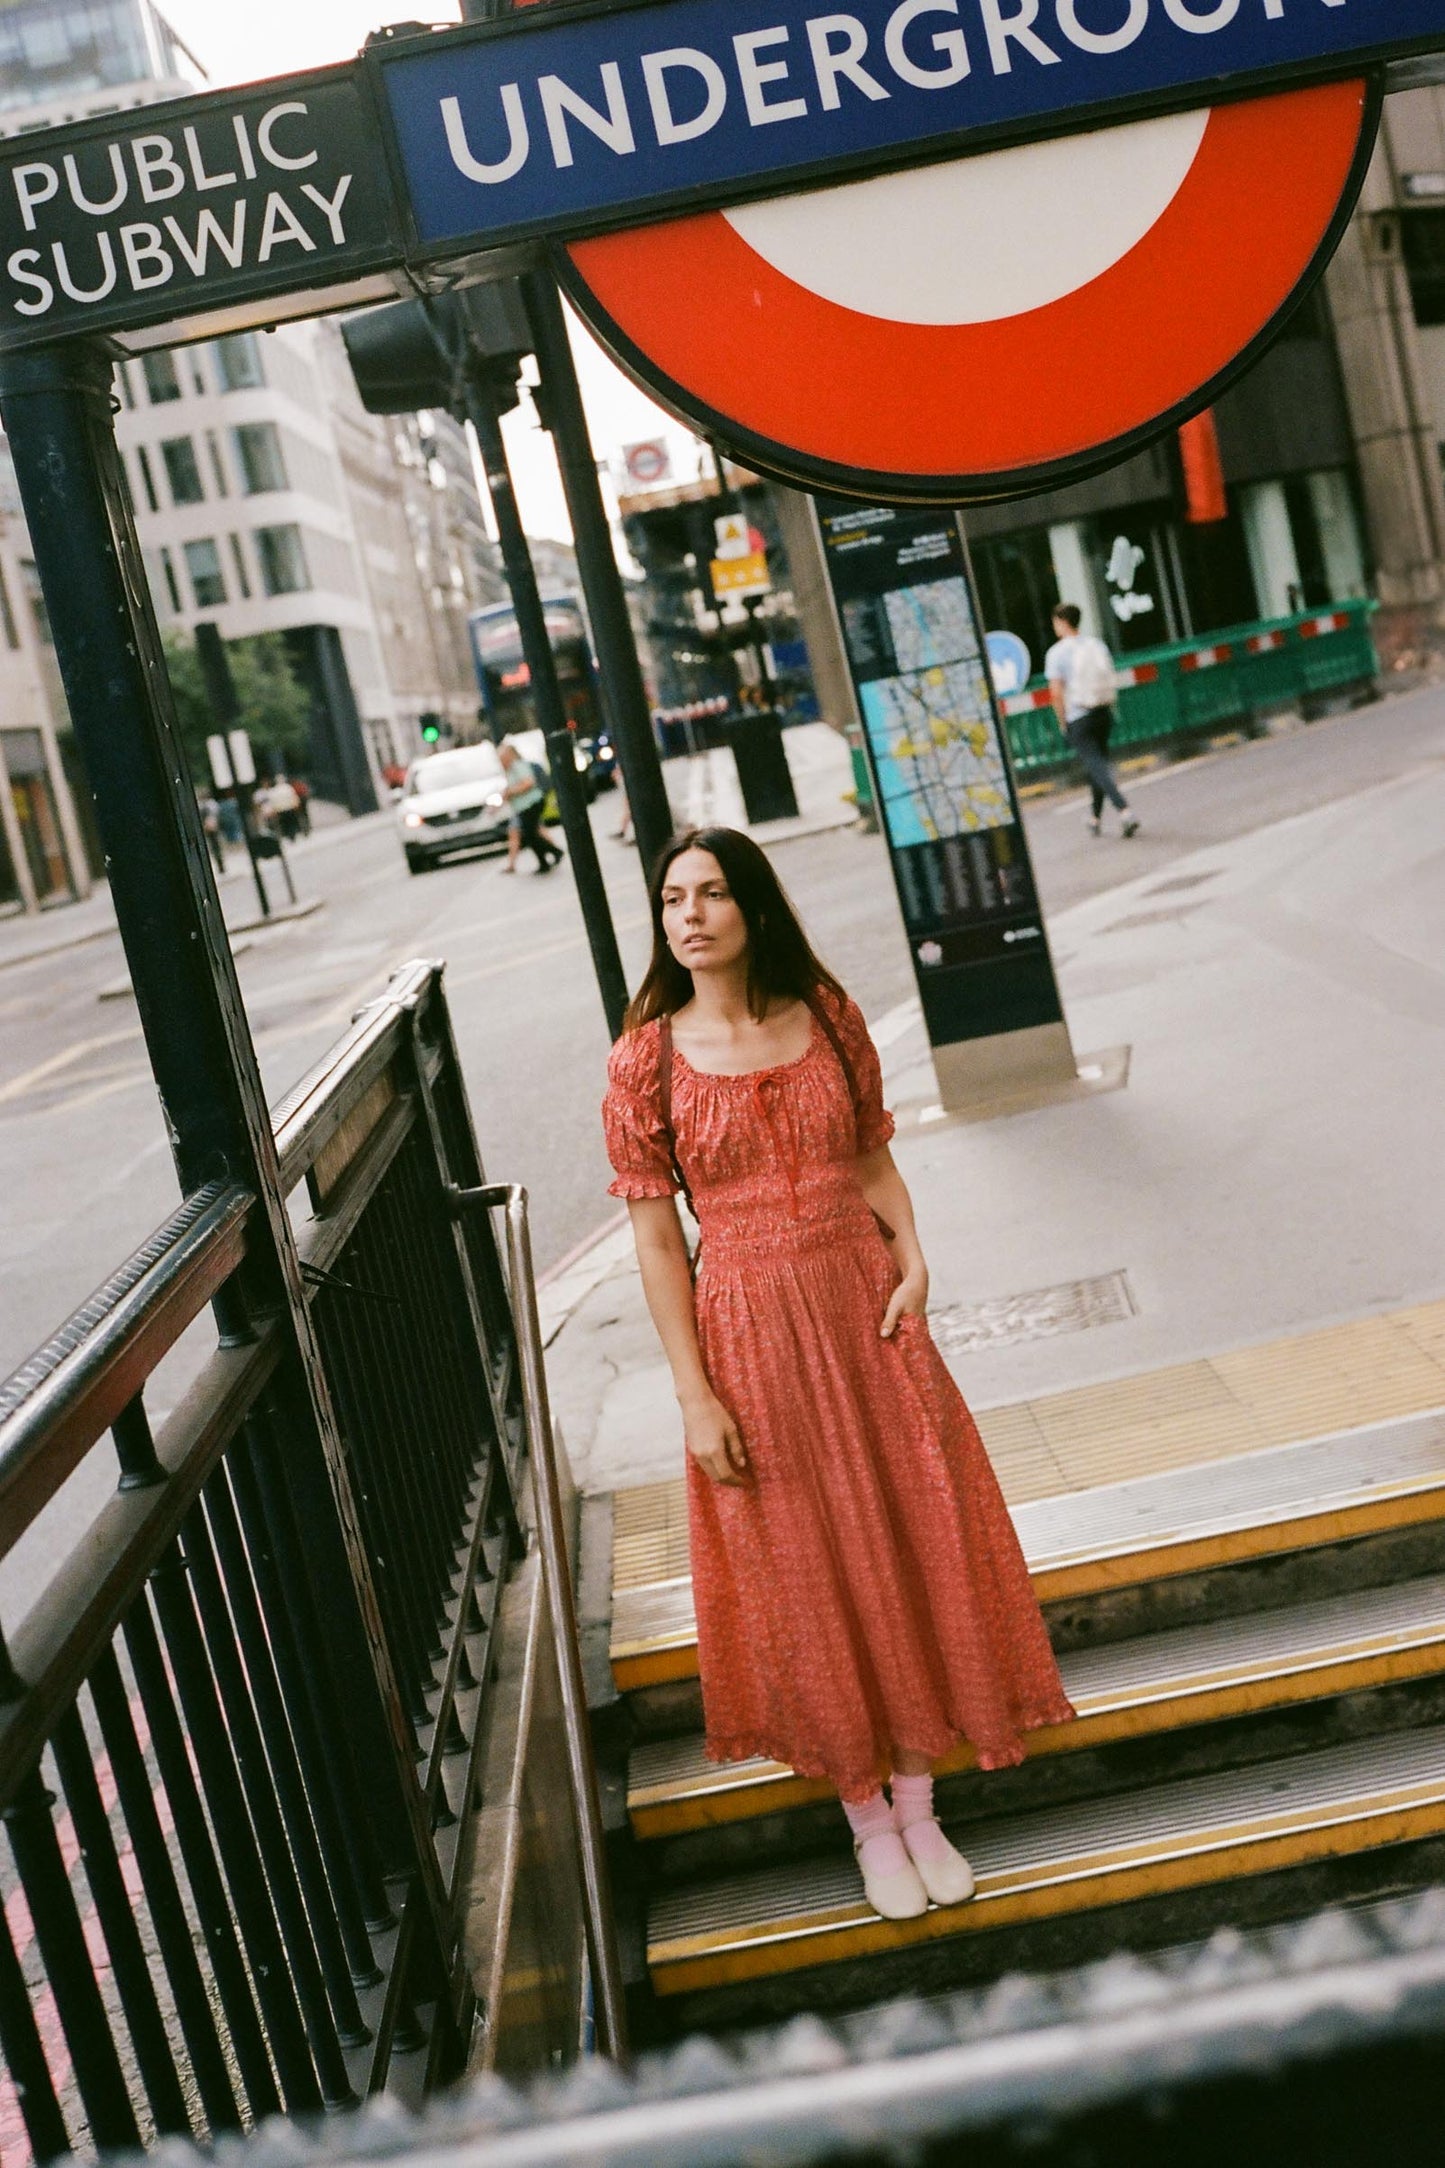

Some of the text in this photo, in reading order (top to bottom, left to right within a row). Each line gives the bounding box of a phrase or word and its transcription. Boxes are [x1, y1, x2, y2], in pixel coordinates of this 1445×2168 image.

[439, 0, 1346, 184] UNDERGRO
[12, 102, 318, 231] PUBLIC
[7, 174, 353, 316] SUBWAY
